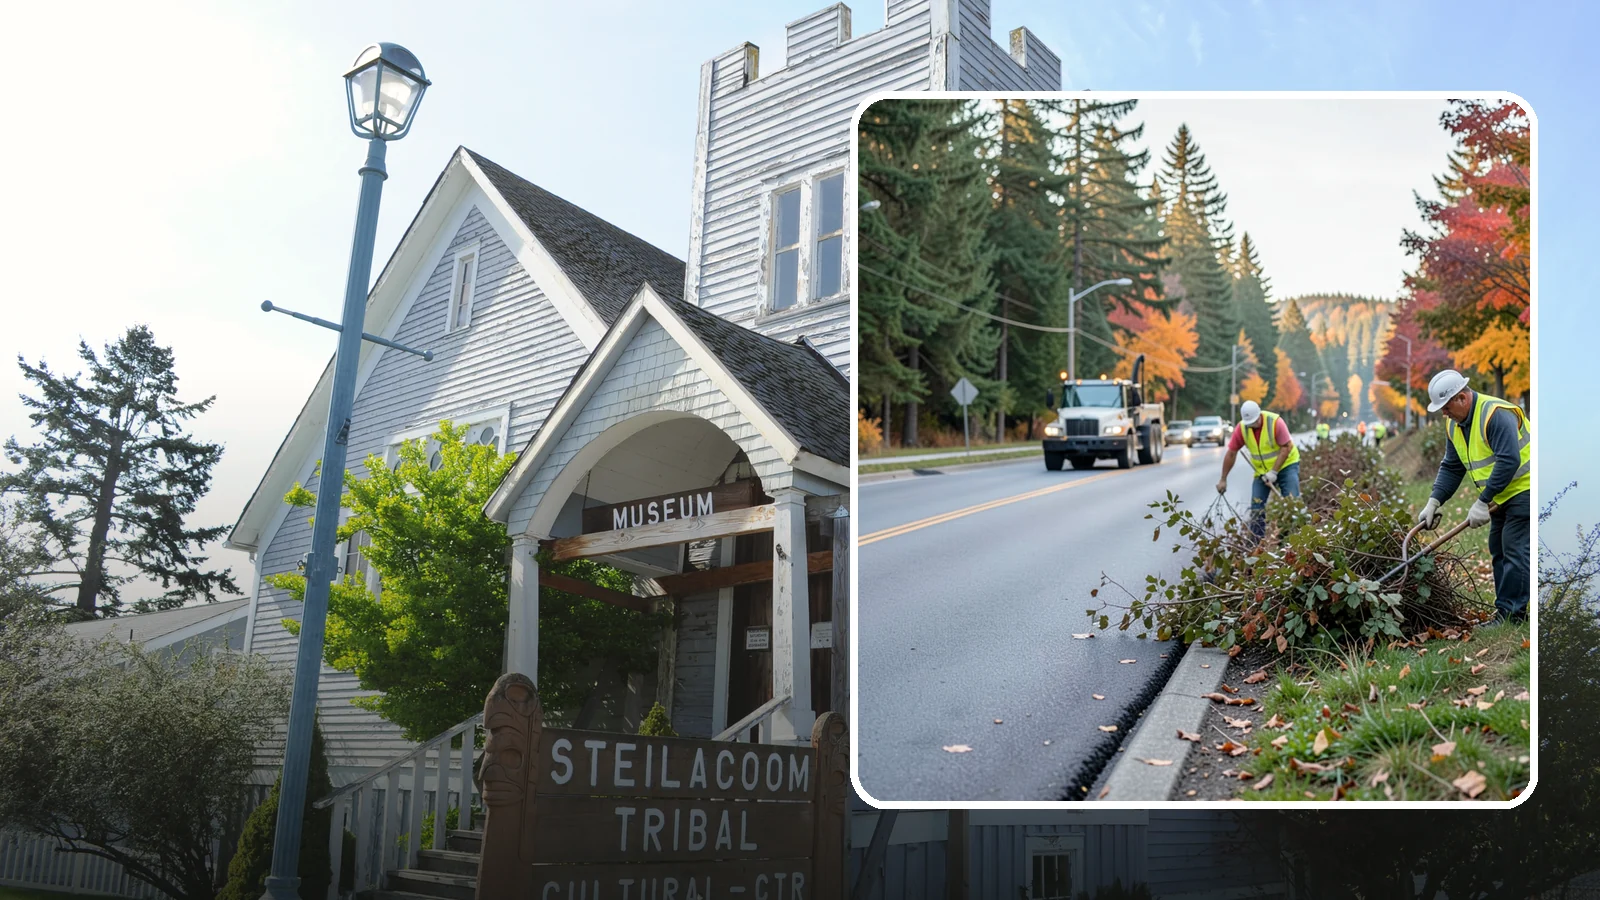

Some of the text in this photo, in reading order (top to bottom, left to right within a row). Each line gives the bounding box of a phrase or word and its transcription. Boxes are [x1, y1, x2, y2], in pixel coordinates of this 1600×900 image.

[612, 492, 713, 530] MUSEUM
[550, 738, 810, 793] STEILACOOM
[614, 806, 758, 852] TRIBAL
[755, 871, 806, 900] CTR
